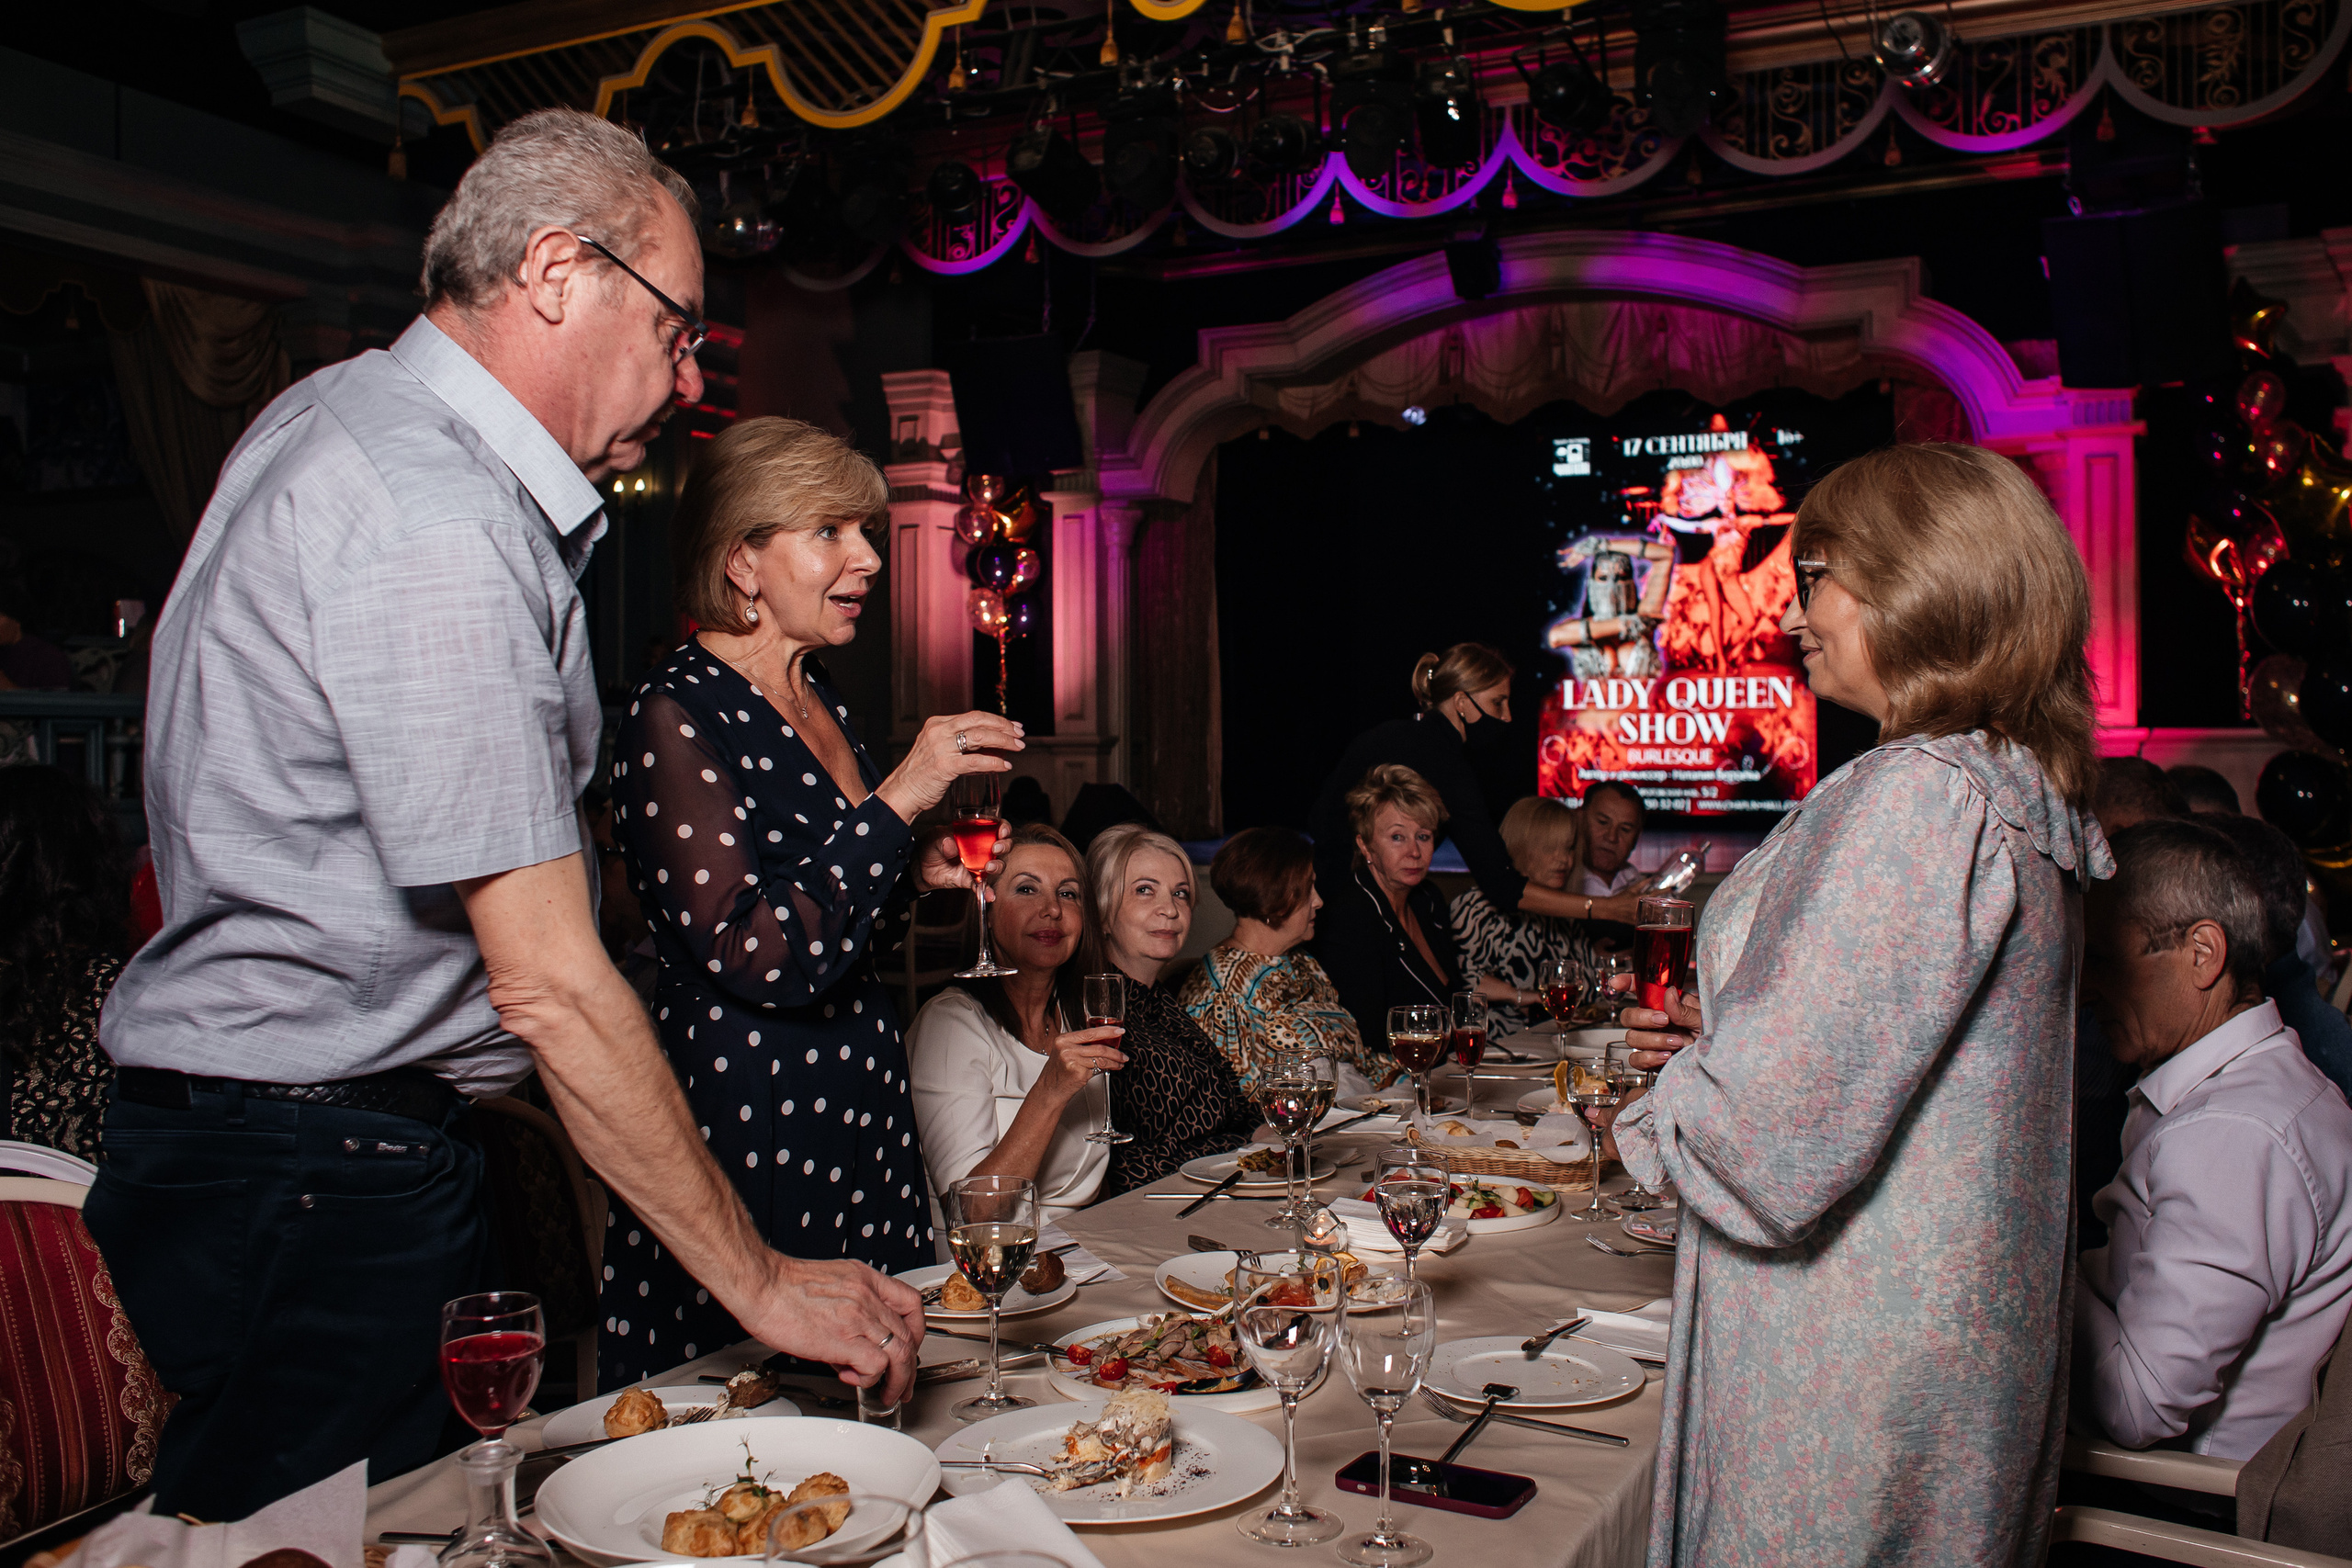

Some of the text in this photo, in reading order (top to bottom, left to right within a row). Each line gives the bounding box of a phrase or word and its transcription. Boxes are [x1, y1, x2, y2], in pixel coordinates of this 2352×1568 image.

[1623, 438, 1642, 457] 17
[1562, 676, 1794, 713] LADY QUEEN
[1618, 712, 1735, 745] SHOW
[1627, 748, 1714, 765] BURLESQUE
